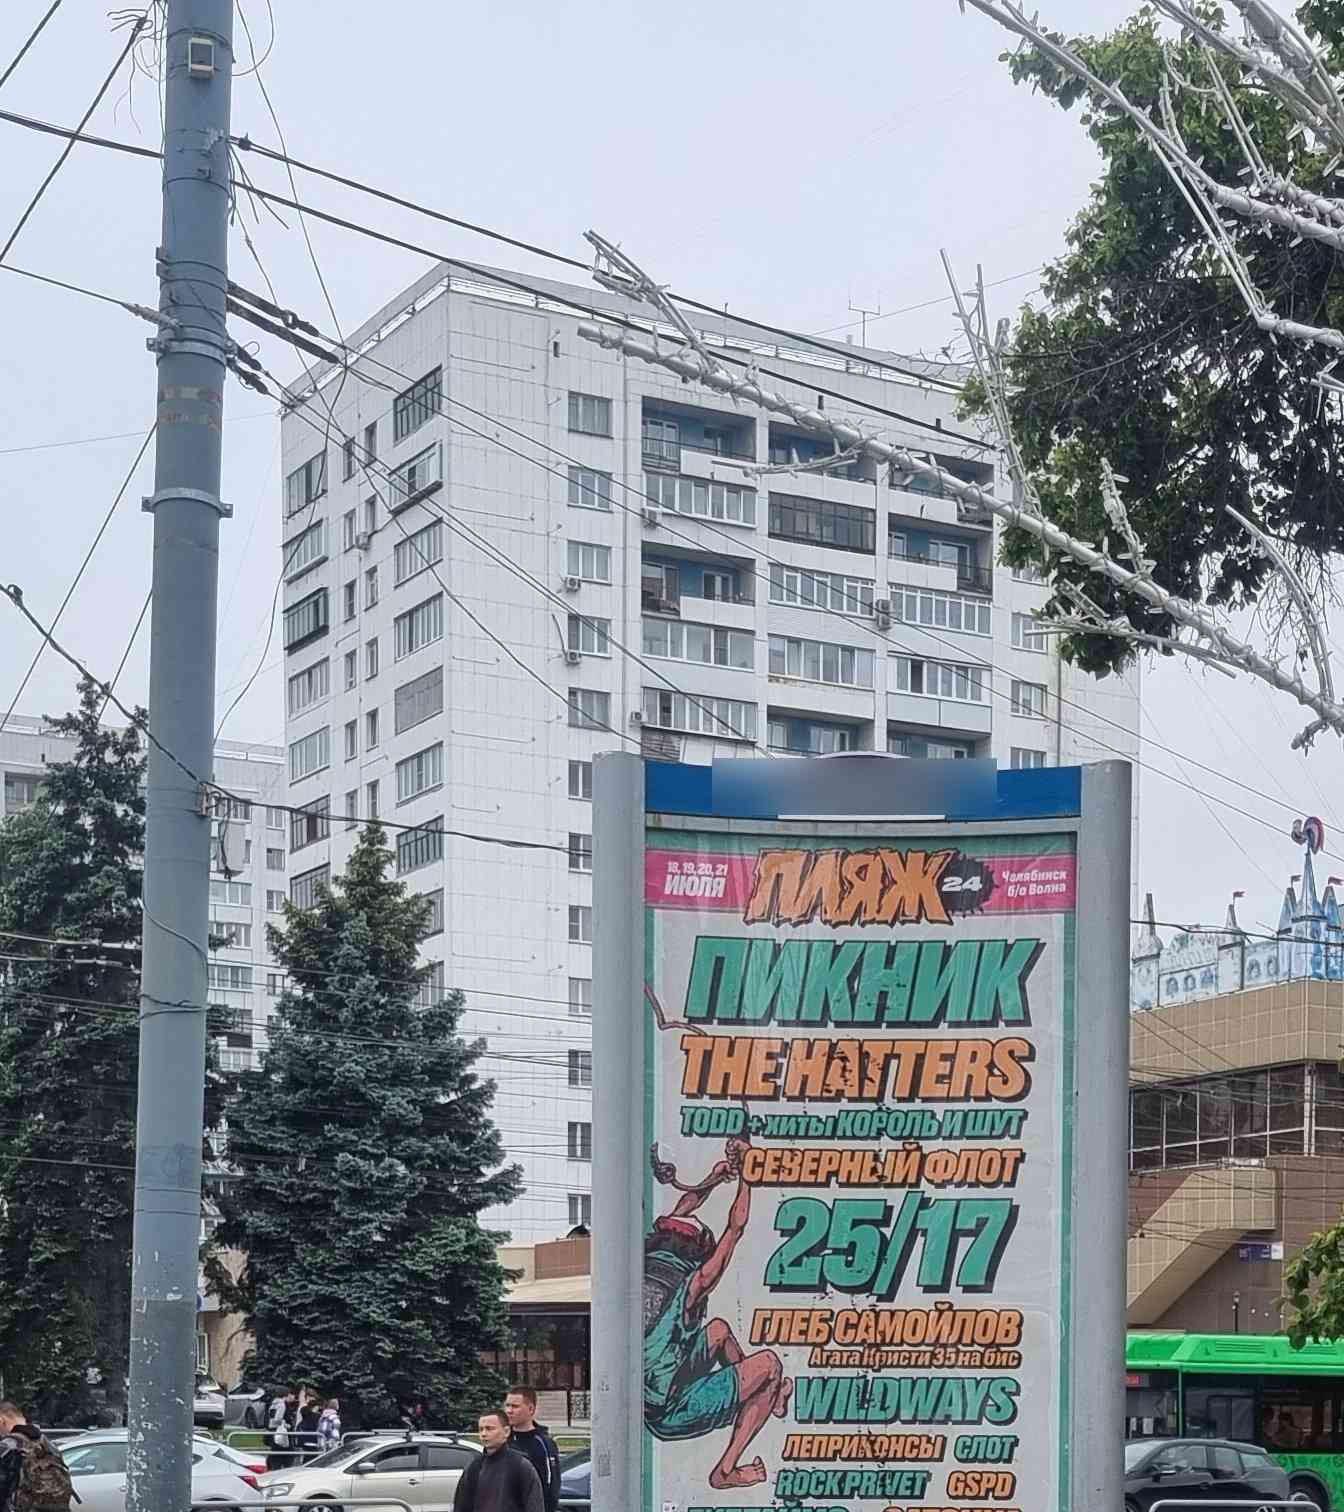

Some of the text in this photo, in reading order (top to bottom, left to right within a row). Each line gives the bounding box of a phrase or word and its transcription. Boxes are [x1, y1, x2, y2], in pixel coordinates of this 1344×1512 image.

[664, 874, 727, 898] ИЮЛЯ
[715, 863, 729, 876] 21
[744, 848, 959, 928] ПЛЯЖ
[941, 876, 982, 892] 24
[684, 936, 1044, 1026] ПИКНИК
[681, 1035, 1034, 1100] THE HATTERS
[681, 1106, 746, 1137] TODD
[837, 1109, 941, 1140] КОРОЛЬ
[942, 1109, 964, 1139] И
[963, 1109, 1027, 1140] ШУТ
[741, 1142, 1025, 1188] СЕВЕРНЫЙ ФЛОТ
[764, 1191, 1018, 1301] 25/17
[749, 1301, 1024, 1347] ГЛЕБ САМОЙЛОВ
[809, 1348, 1022, 1371] Агата Кристи 35 на бис
[795, 1376, 1020, 1424] WILDWAYS
[783, 1434, 1018, 1464] ЛЕПРИКОНСЫ СЛОТ
[775, 1469, 1017, 1499] ROCK PRIVET GSPD
